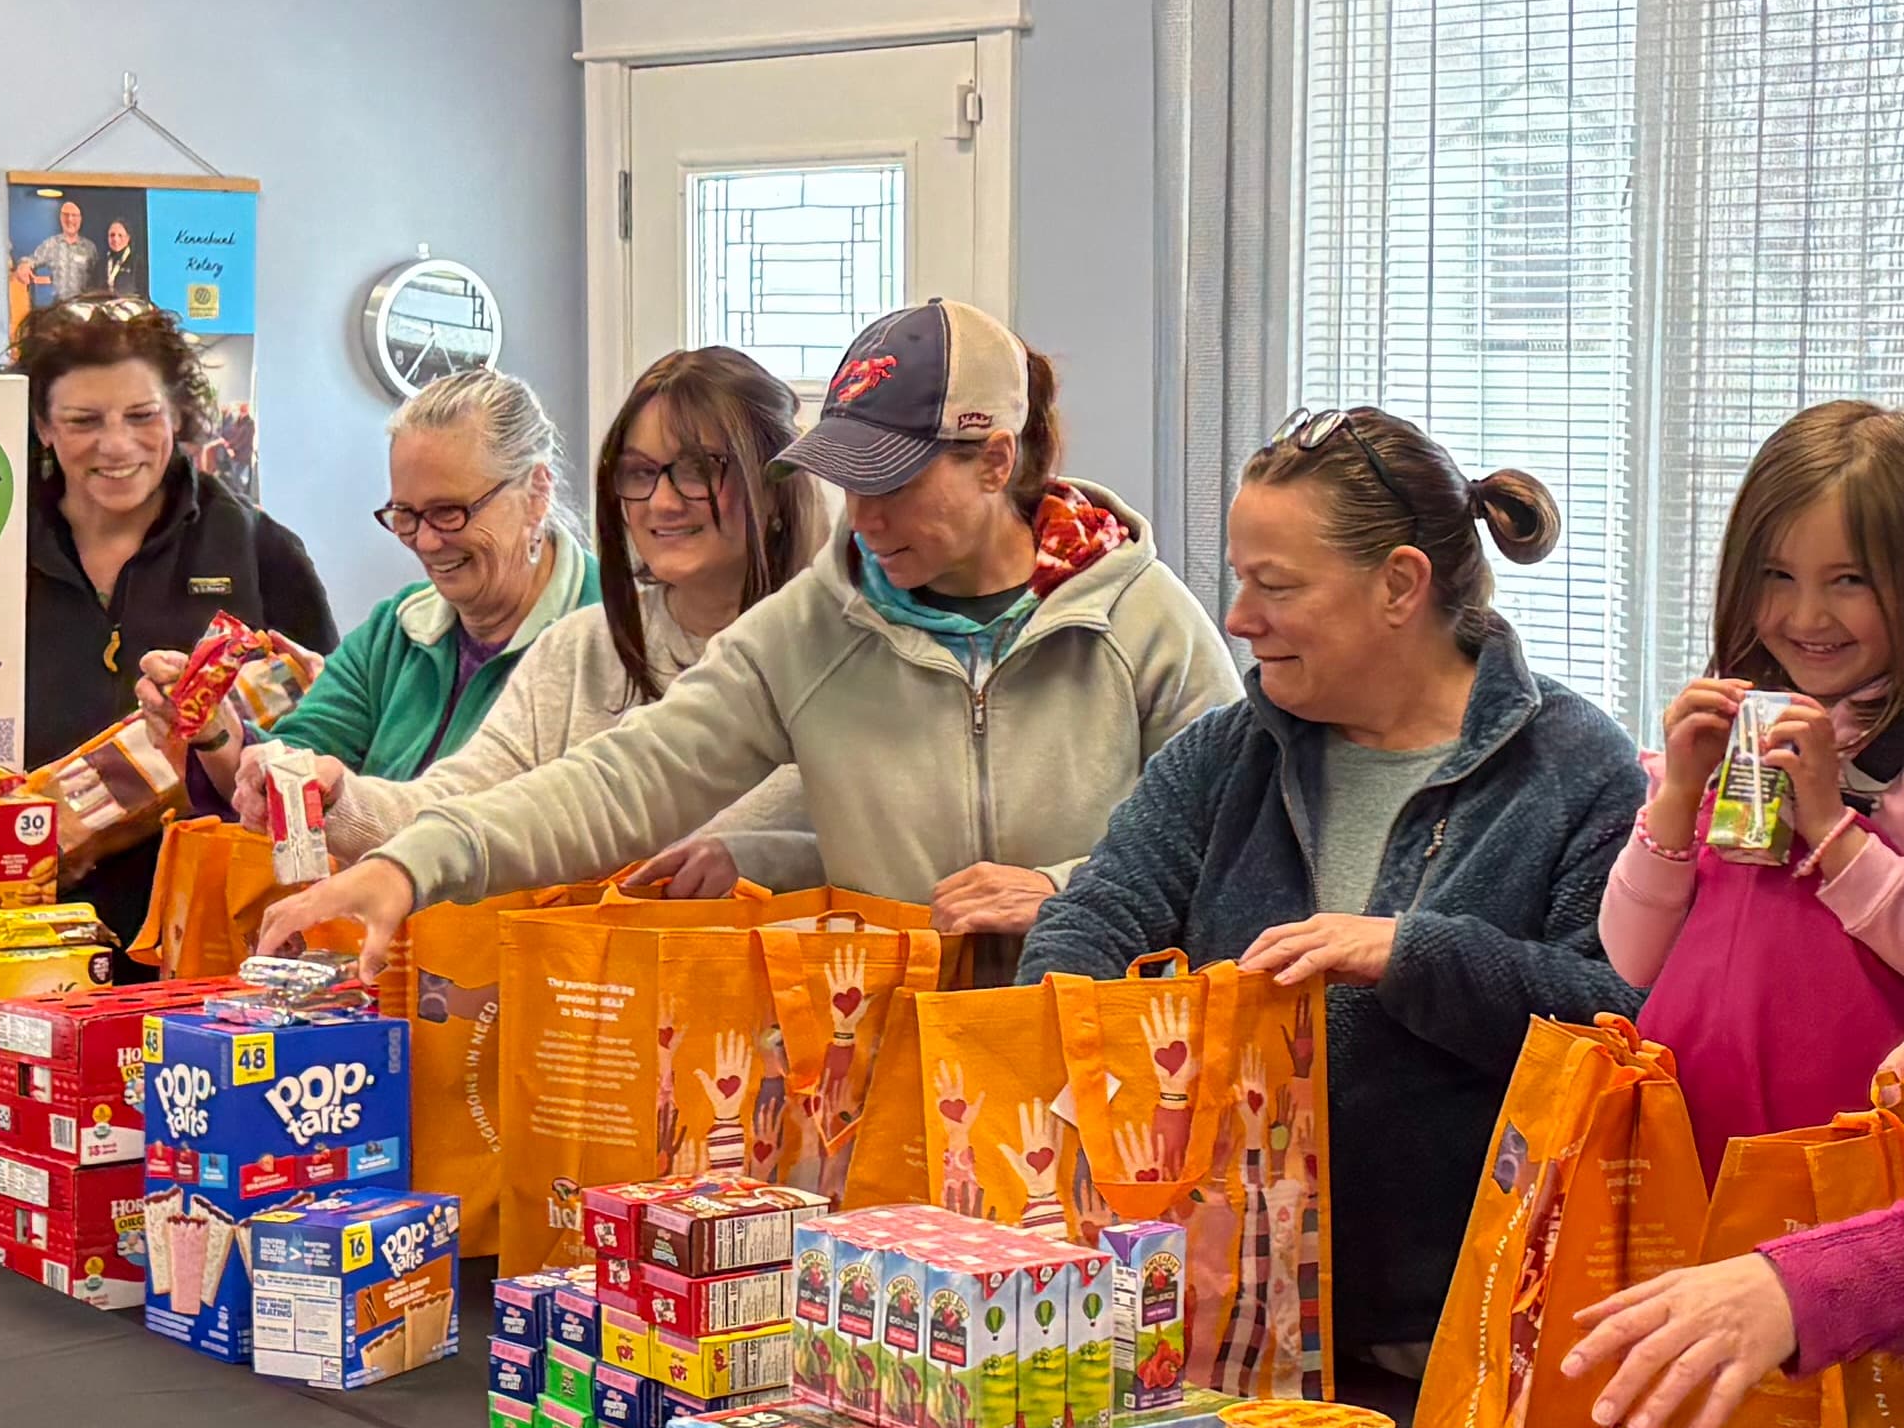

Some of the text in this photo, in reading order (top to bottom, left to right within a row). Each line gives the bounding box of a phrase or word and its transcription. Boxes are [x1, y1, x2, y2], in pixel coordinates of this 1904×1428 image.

[174, 229, 237, 246] Kennebunk
[185, 258, 225, 278] Rotary
[20, 815, 46, 832] 30
[465, 1001, 499, 1068] IN NEED
[238, 1046, 267, 1070] 48
[349, 1236, 365, 1258] 16
[725, 1411, 784, 1428] 36
